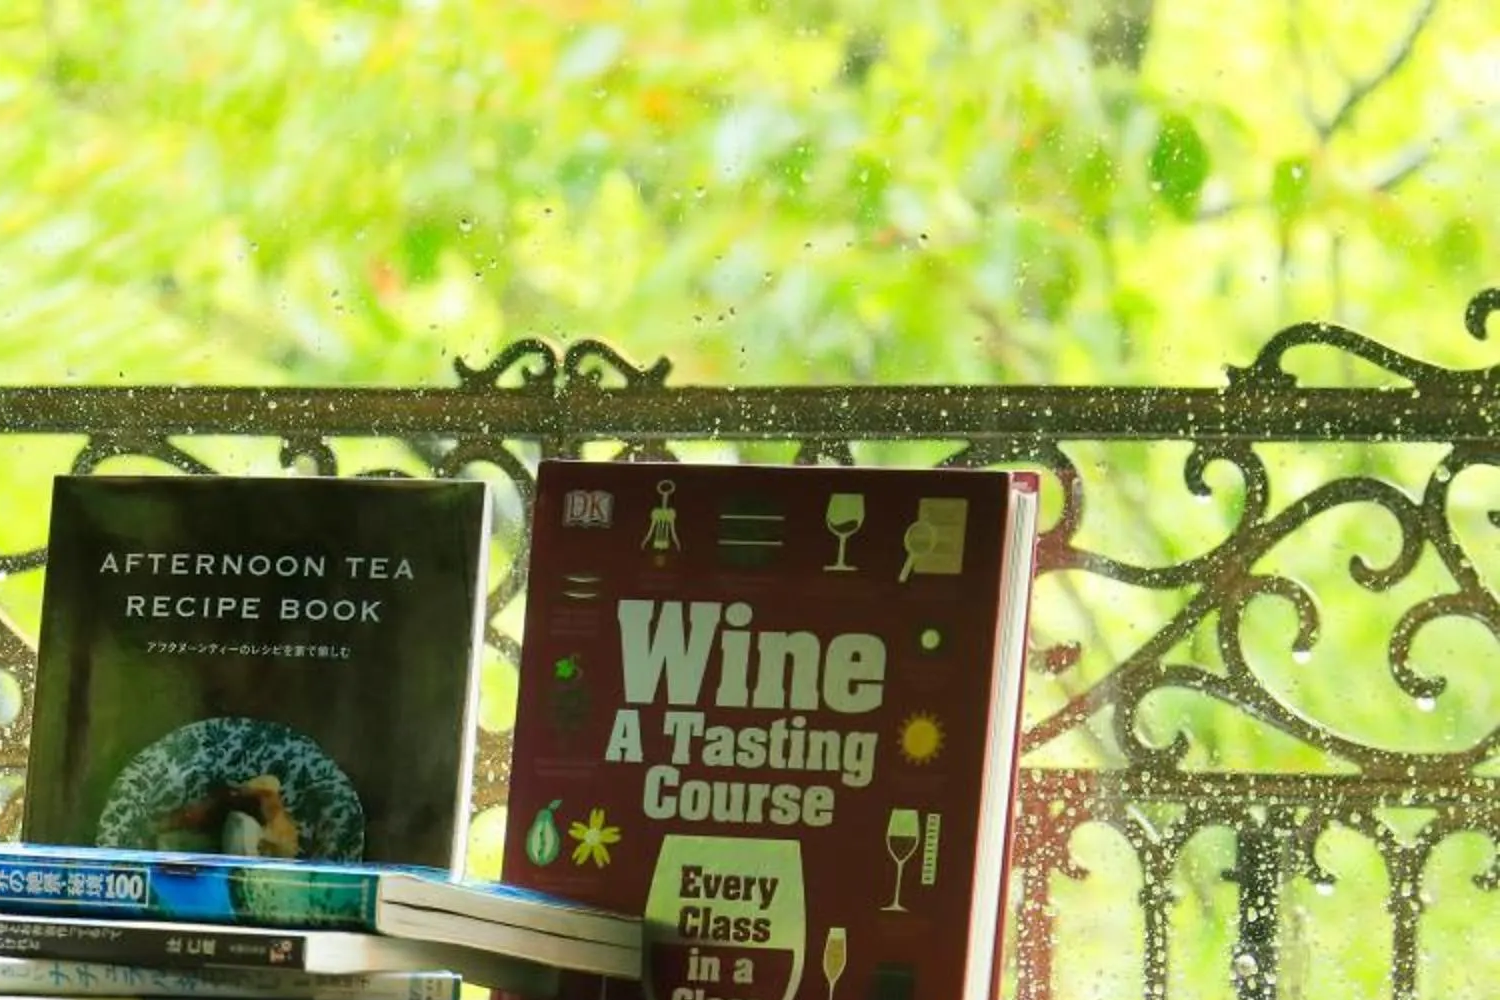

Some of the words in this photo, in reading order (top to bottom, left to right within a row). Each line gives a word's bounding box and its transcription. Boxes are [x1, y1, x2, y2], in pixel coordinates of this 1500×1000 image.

[570, 493, 607, 521] DK
[99, 552, 326, 578] AFTERNOON
[345, 556, 415, 580] TEA
[126, 595, 261, 619] RECIPE
[280, 600, 382, 622] BOOK
[617, 599, 887, 713] Wine
[605, 709, 644, 763] A
[663, 711, 879, 788] Tasting
[643, 765, 835, 826] Course
[678, 865, 779, 905] Every
[677, 906, 772, 944] Class
[687, 947, 721, 983] in
[733, 955, 754, 984] a
